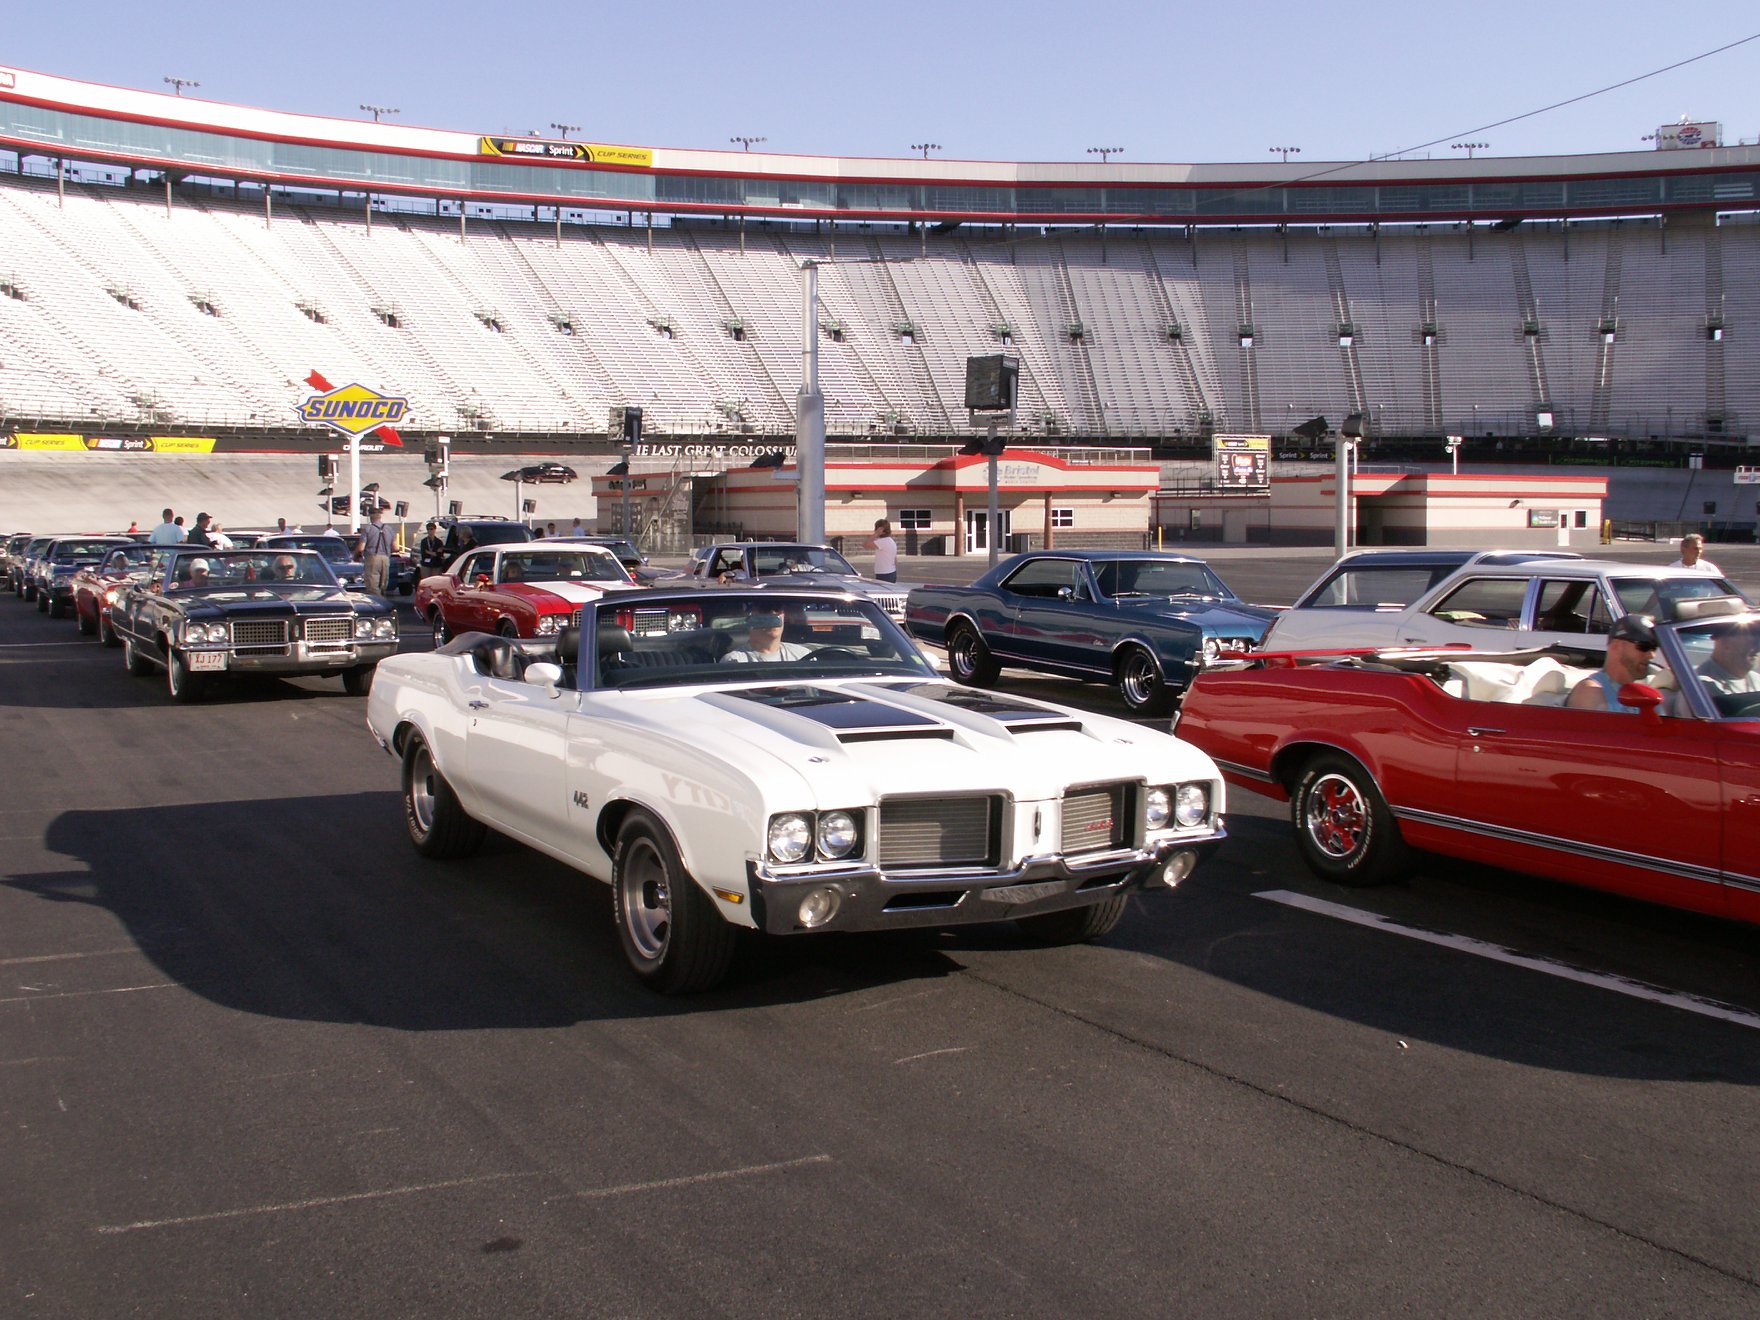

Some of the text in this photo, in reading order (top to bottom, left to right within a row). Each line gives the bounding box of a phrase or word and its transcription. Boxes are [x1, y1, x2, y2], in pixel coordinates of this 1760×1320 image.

[515, 143, 545, 154] NASCAR
[548, 145, 574, 157] Sprint
[617, 152, 648, 160] SERIES
[307, 400, 404, 418] SUNOCO
[124, 440, 144, 449] Sprint
[651, 444, 682, 456] LAST
[685, 445, 725, 456] GREAT
[729, 445, 797, 456] COLOSSU
[1279, 451, 1298, 459] Sprint
[1310, 451, 1328, 459] Sprint
[1004, 465, 1040, 475] Bristol
[195, 654, 222, 663] XJ 177
